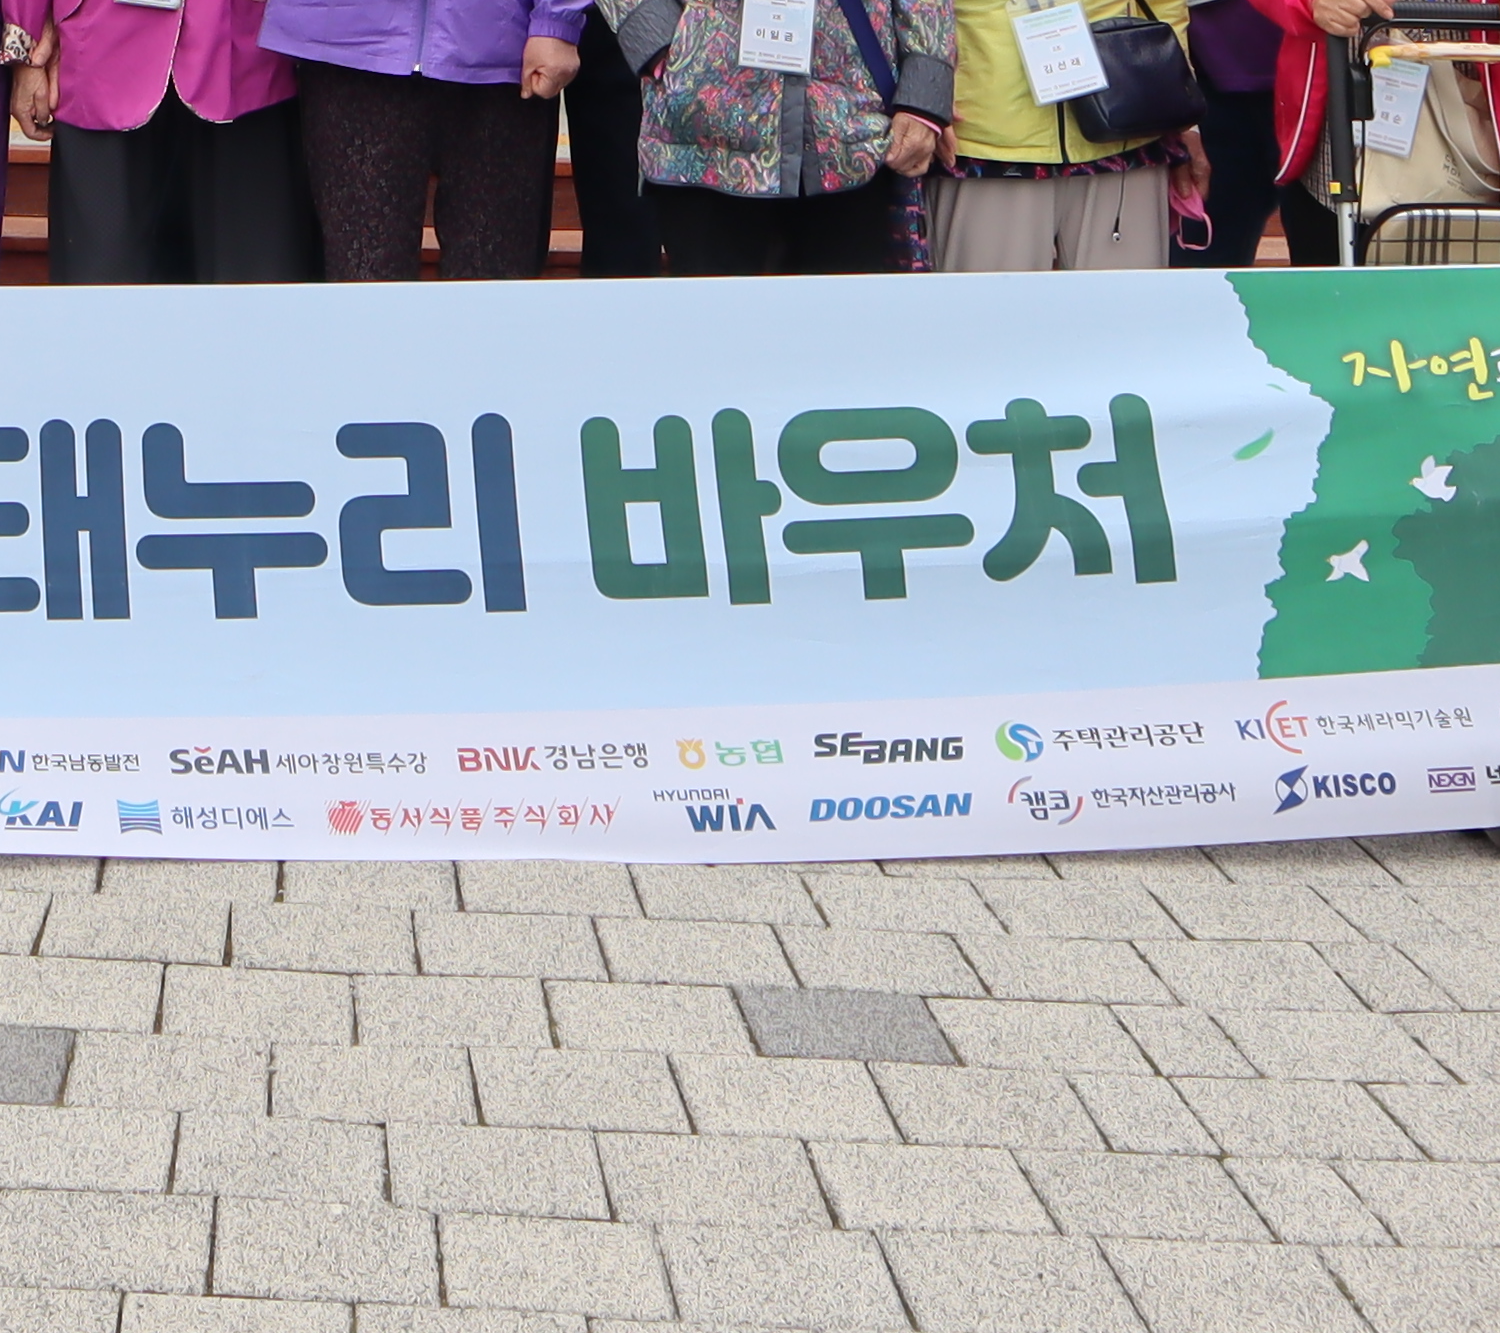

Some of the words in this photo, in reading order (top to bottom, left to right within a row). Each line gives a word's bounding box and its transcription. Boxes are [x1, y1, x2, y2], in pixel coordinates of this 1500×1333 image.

[579, 392, 1180, 607] 바우처
[1052, 721, 1205, 751] 주택관리공단
[1315, 706, 1474, 736] 한국세라믹기술원
[31, 753, 140, 773] 한국남동발전
[275, 752, 428, 775] 세아창원특수강
[456, 746, 542, 772] BNK
[544, 742, 650, 771] 경남은행
[714, 738, 785, 767] 농협
[813, 732, 964, 765] SEBANG
[652, 788, 730, 802] HYUNDAI
[1312, 771, 1397, 799] KISCO
[1428, 770, 1477, 790] NEXEN
[2, 800, 83, 827] KAI
[808, 792, 973, 822] DOOSAN
[1020, 789, 1071, 821] 캠코
[1090, 782, 1237, 809] 한국자산관리공사
[170, 806, 295, 831] 해성디에스
[368, 801, 616, 833] 동서식품주식회사
[685, 801, 777, 833] WIA
